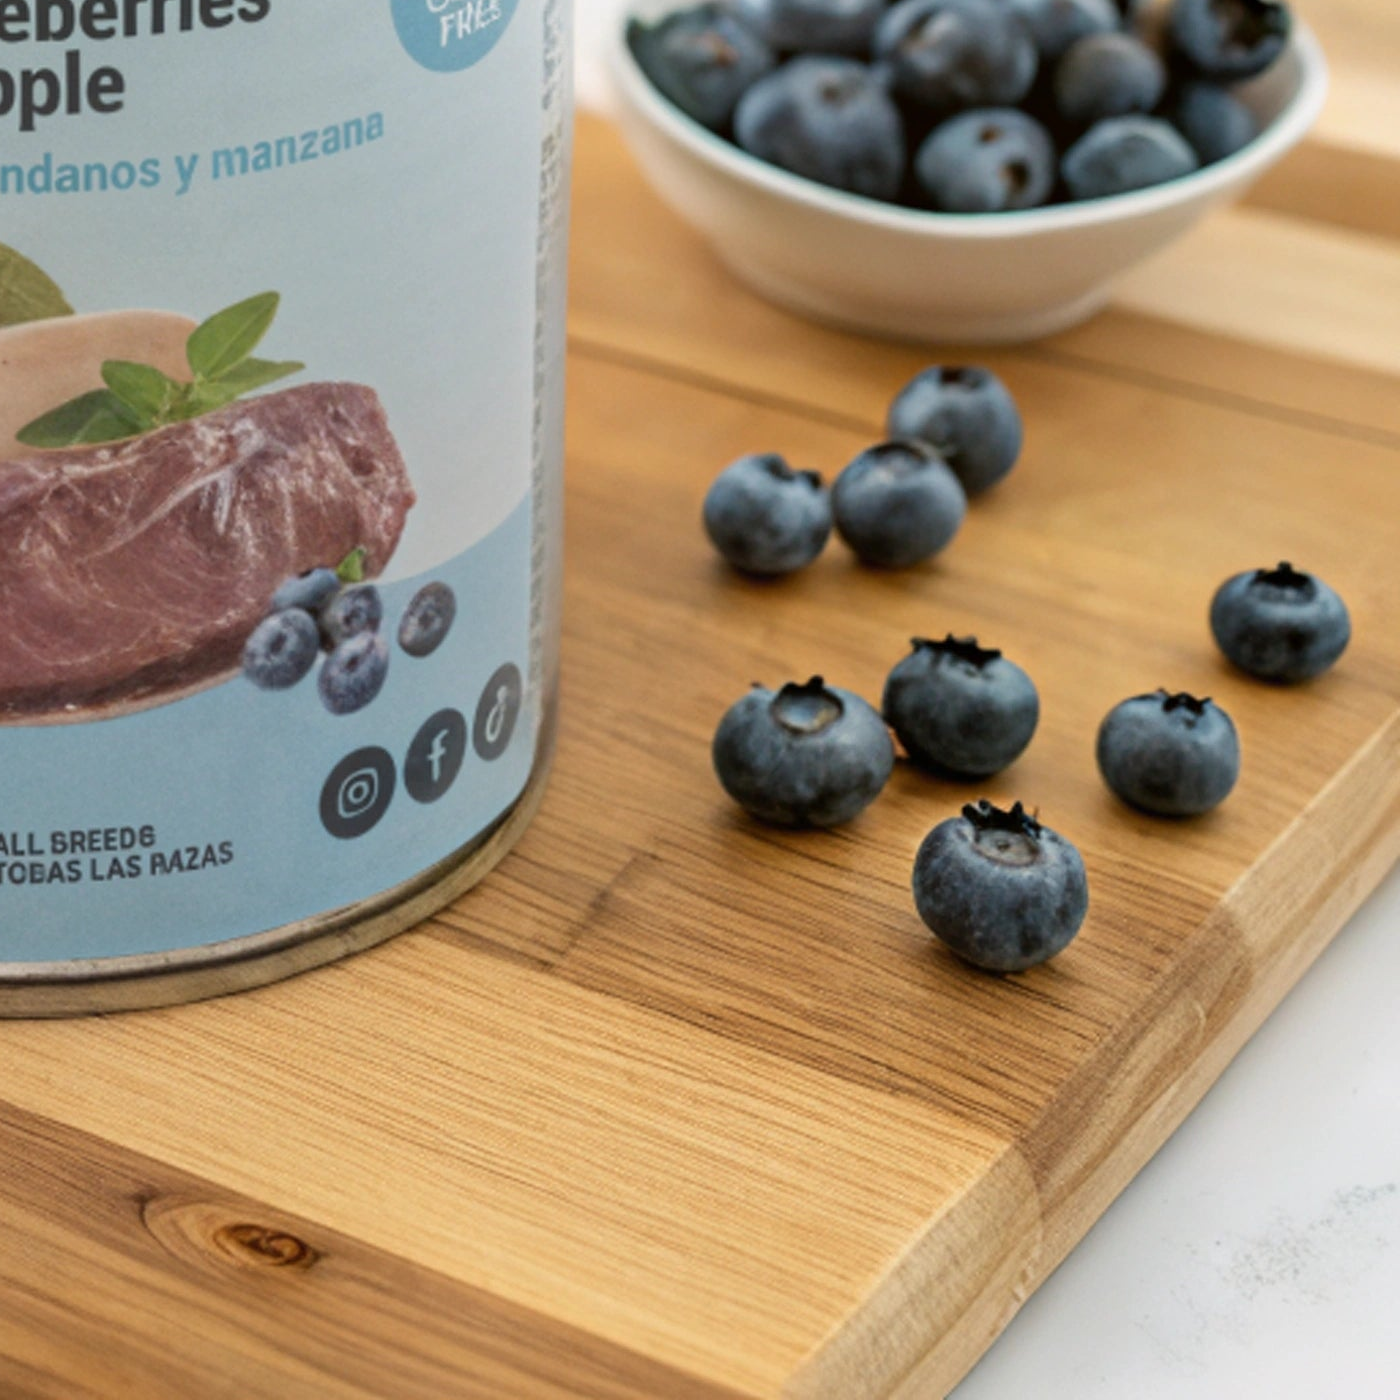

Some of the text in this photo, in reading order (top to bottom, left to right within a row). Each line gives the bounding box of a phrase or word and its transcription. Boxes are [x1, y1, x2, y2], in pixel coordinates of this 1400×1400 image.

[174, 153, 199, 196] y
[211, 111, 385, 180] manzana
[90, 855, 142, 881] LAS
